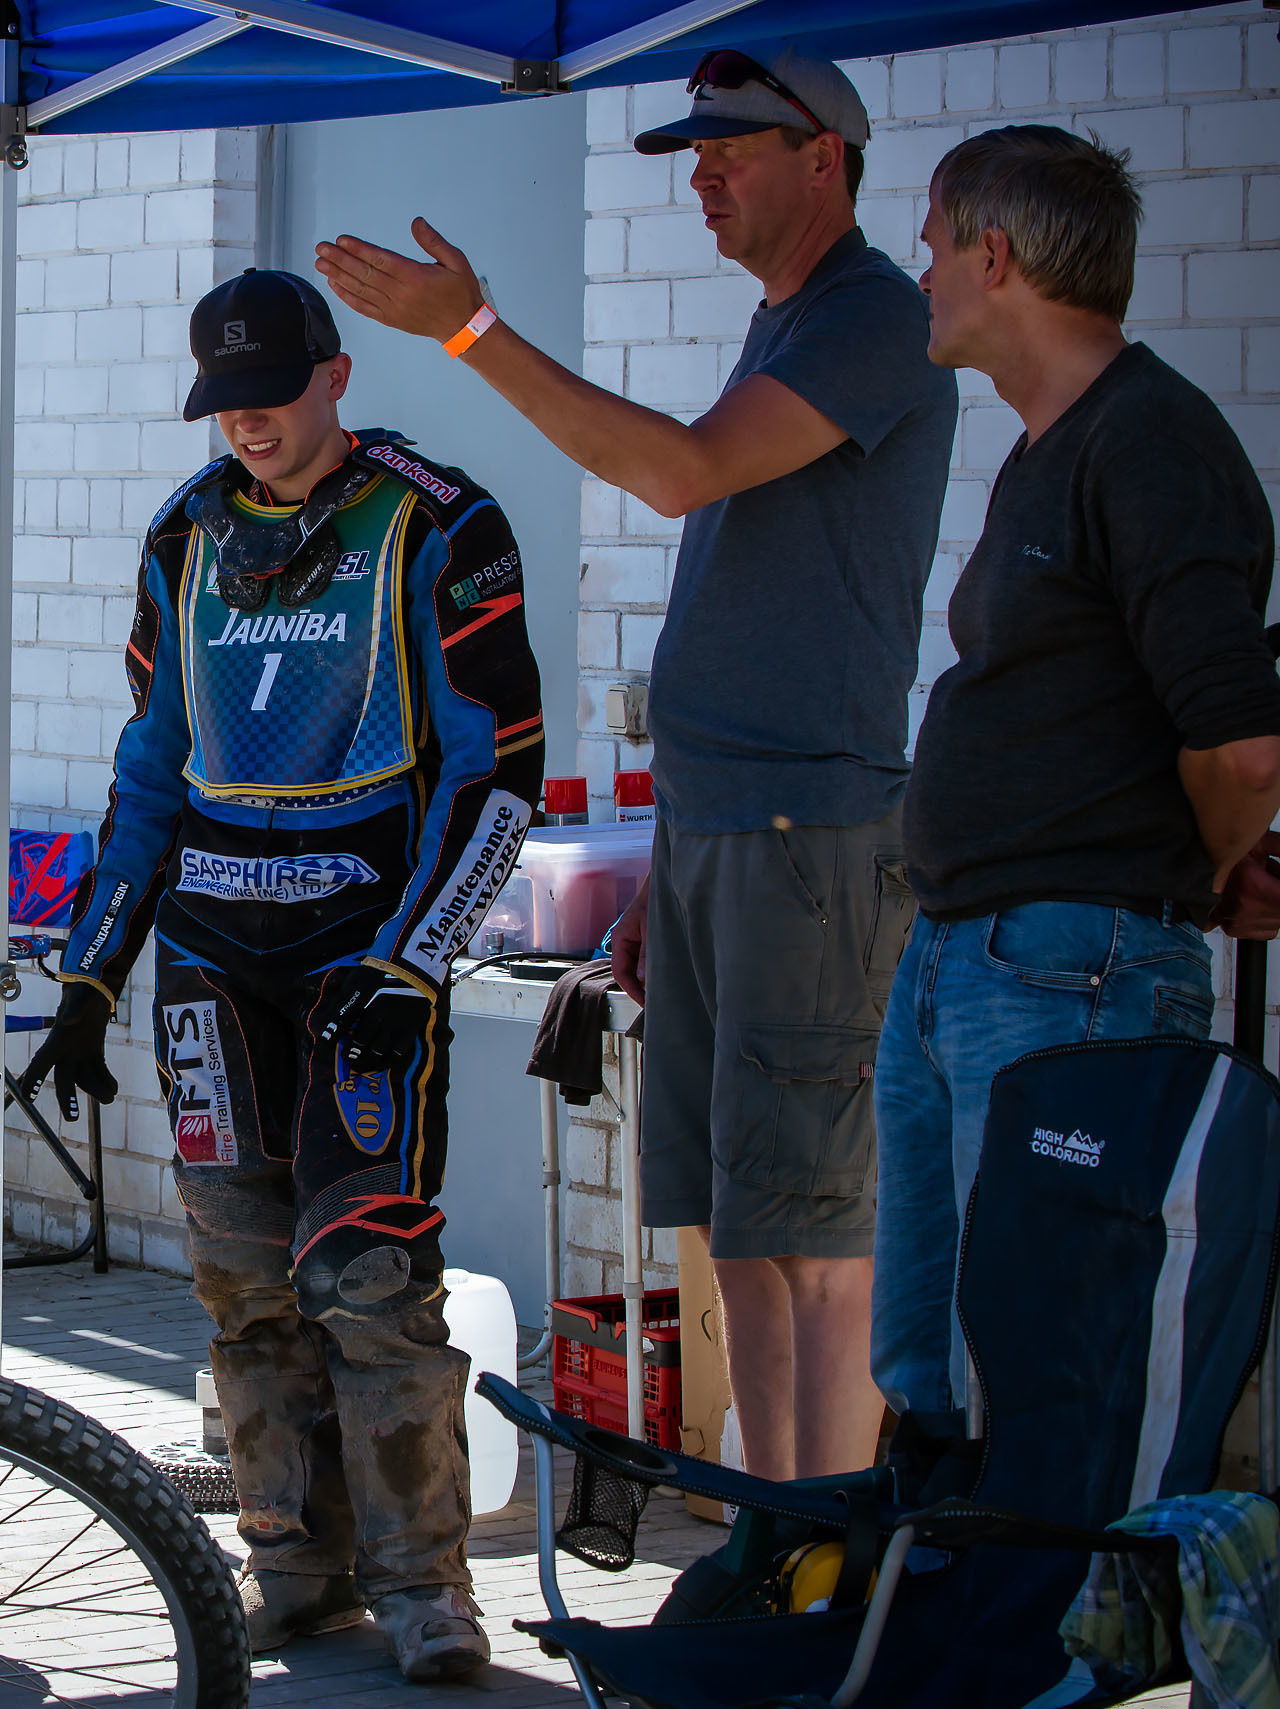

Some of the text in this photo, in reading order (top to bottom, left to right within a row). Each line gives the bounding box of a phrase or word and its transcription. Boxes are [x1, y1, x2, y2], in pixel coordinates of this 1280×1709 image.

[367, 446, 461, 504] dankemi
[208, 608, 346, 646] JAUNĪBA
[251, 653, 282, 711] 1
[181, 877, 254, 898] ENGINEERING
[184, 853, 322, 888] SAPPHIRE
[416, 806, 513, 961] Maintenance
[440, 816, 527, 965] NETWORK
[167, 1008, 211, 1111] FTS
[203, 1009, 234, 1162] Fire Training Services
[1032, 1140, 1100, 1167] COLORADO
[1033, 1127, 1064, 1146] HIGH
